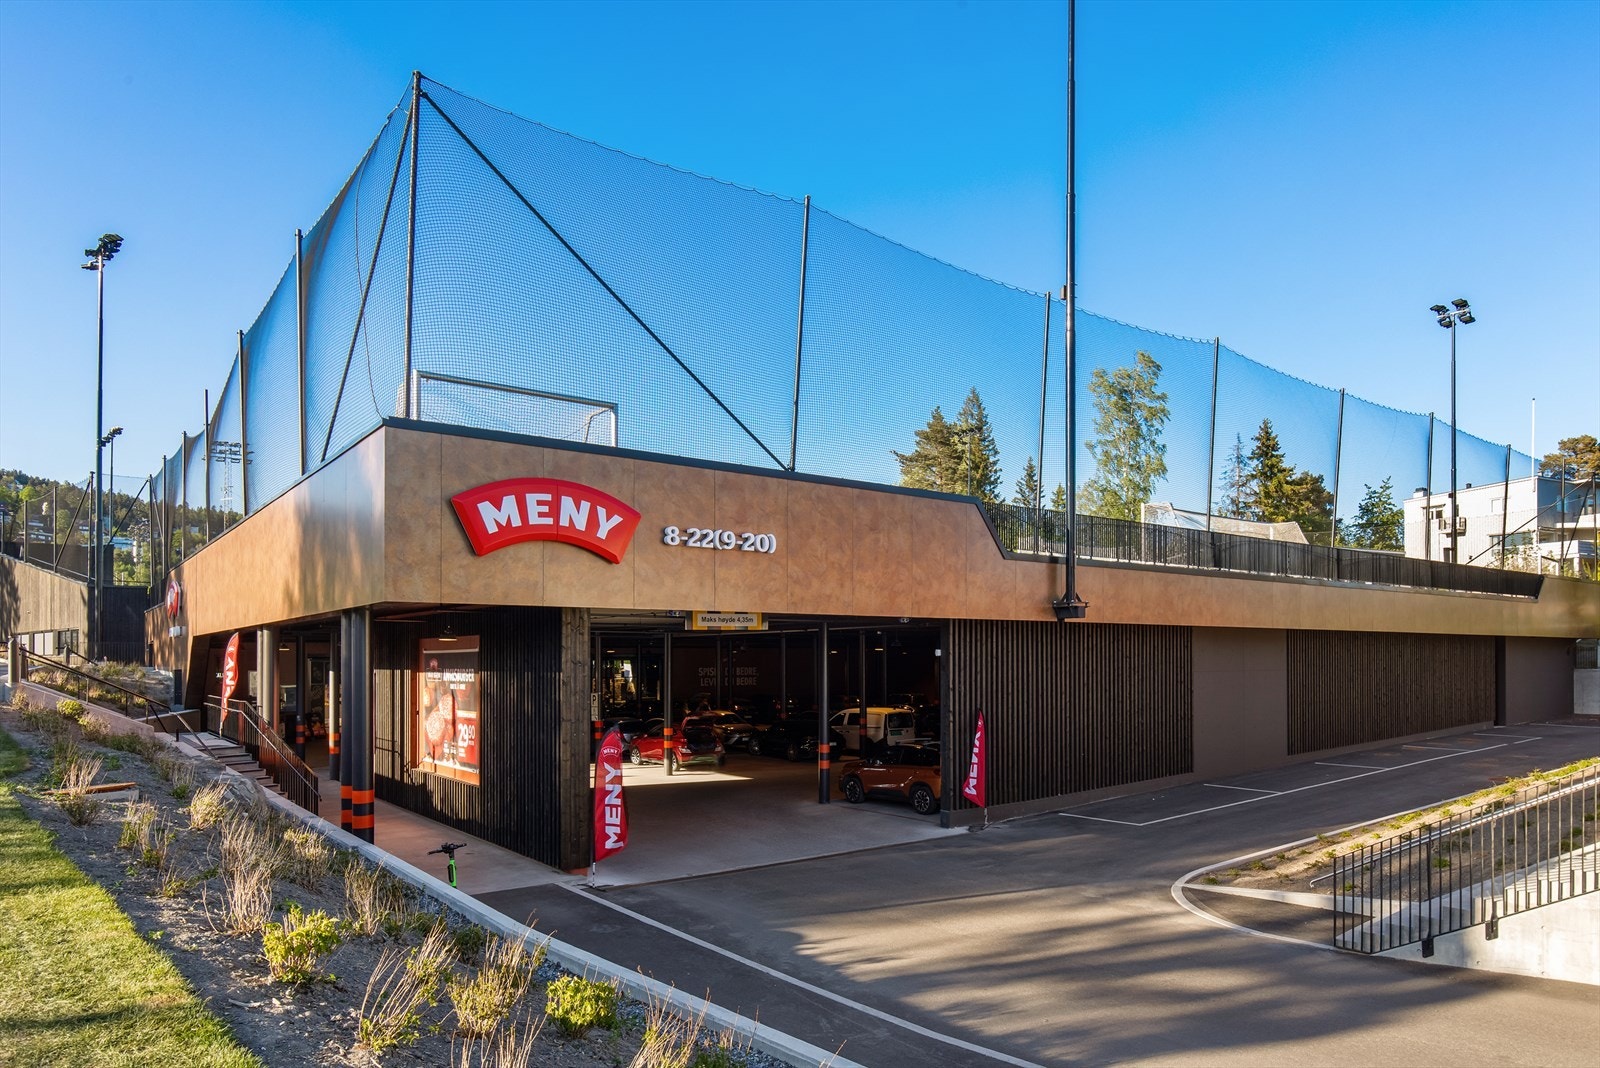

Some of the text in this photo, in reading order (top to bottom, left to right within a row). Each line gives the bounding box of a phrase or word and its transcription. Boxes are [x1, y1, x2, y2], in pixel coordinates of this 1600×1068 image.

[476, 493, 623, 540] MENY
[663, 525, 777, 554] 8-22(9-20)
[717, 616, 736, 624] høyde
[603, 762, 624, 850] MENY
